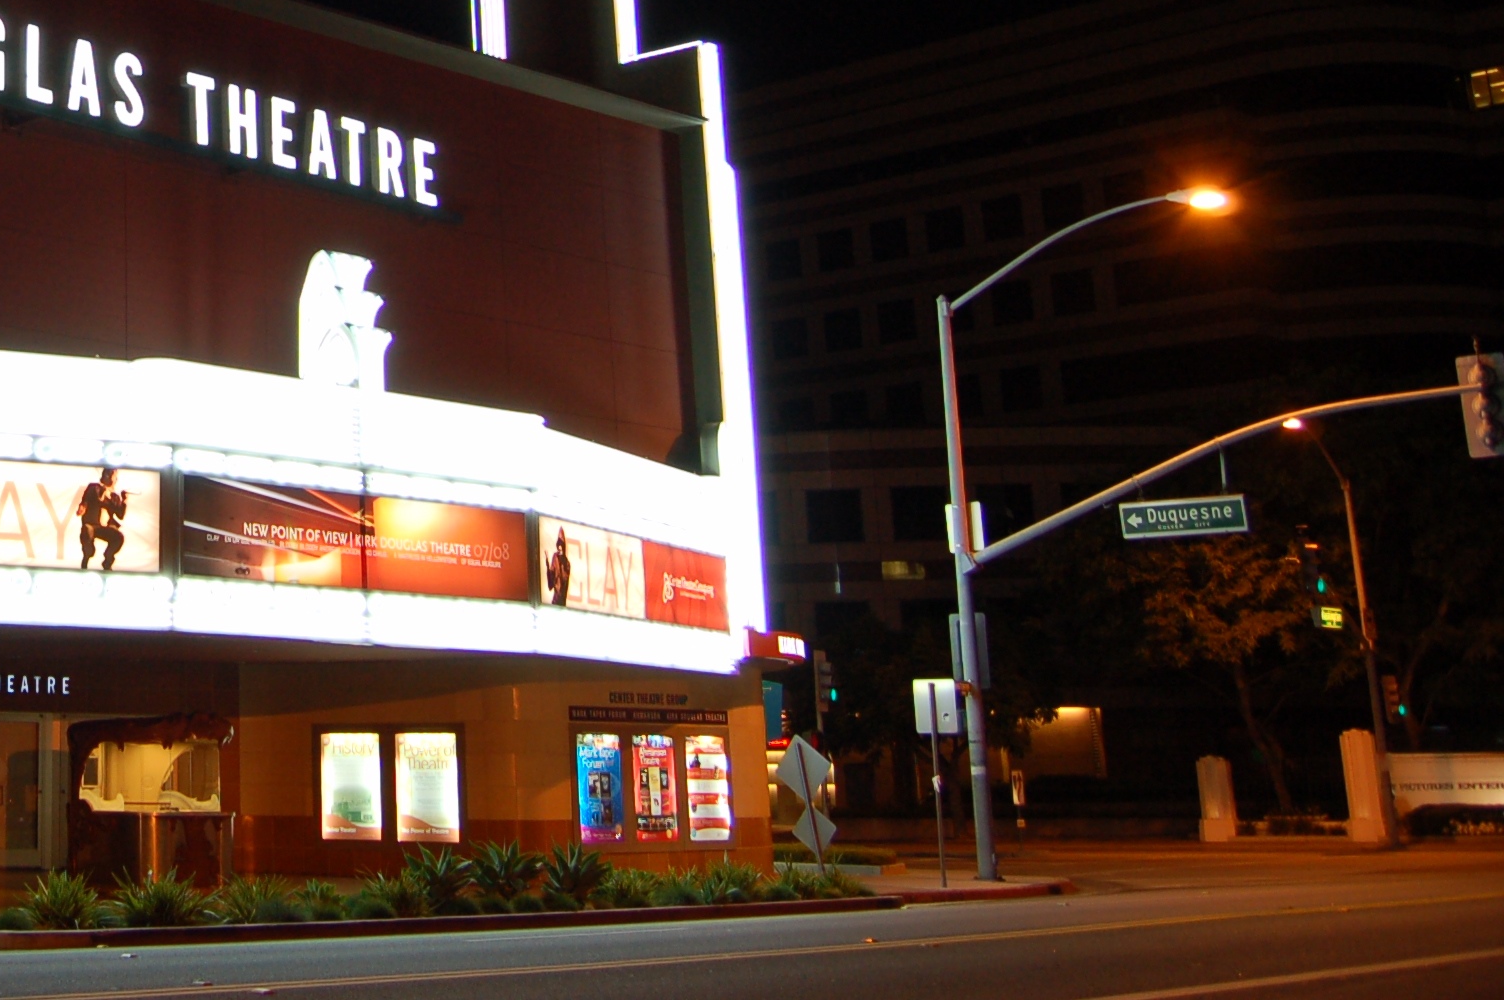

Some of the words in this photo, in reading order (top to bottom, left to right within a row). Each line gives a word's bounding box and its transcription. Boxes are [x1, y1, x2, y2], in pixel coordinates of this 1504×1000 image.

[184, 71, 439, 207] THEATRE
[1147, 505, 1233, 524] Duquesne
[243, 522, 269, 538] NEW
[271, 525, 304, 541] POINT
[306, 529, 321, 541] OF
[322, 530, 348, 545] VIEW
[355, 533, 377, 548] KIRK
[380, 536, 428, 553] DOUGLAS
[430, 541, 472, 558] THEATRE
[473, 541, 510, 561] 07/08
[564, 537, 632, 611] CLAY
[332, 742, 375, 757] History
[403, 743, 441, 757] Power
[408, 757, 449, 770] Theatr
